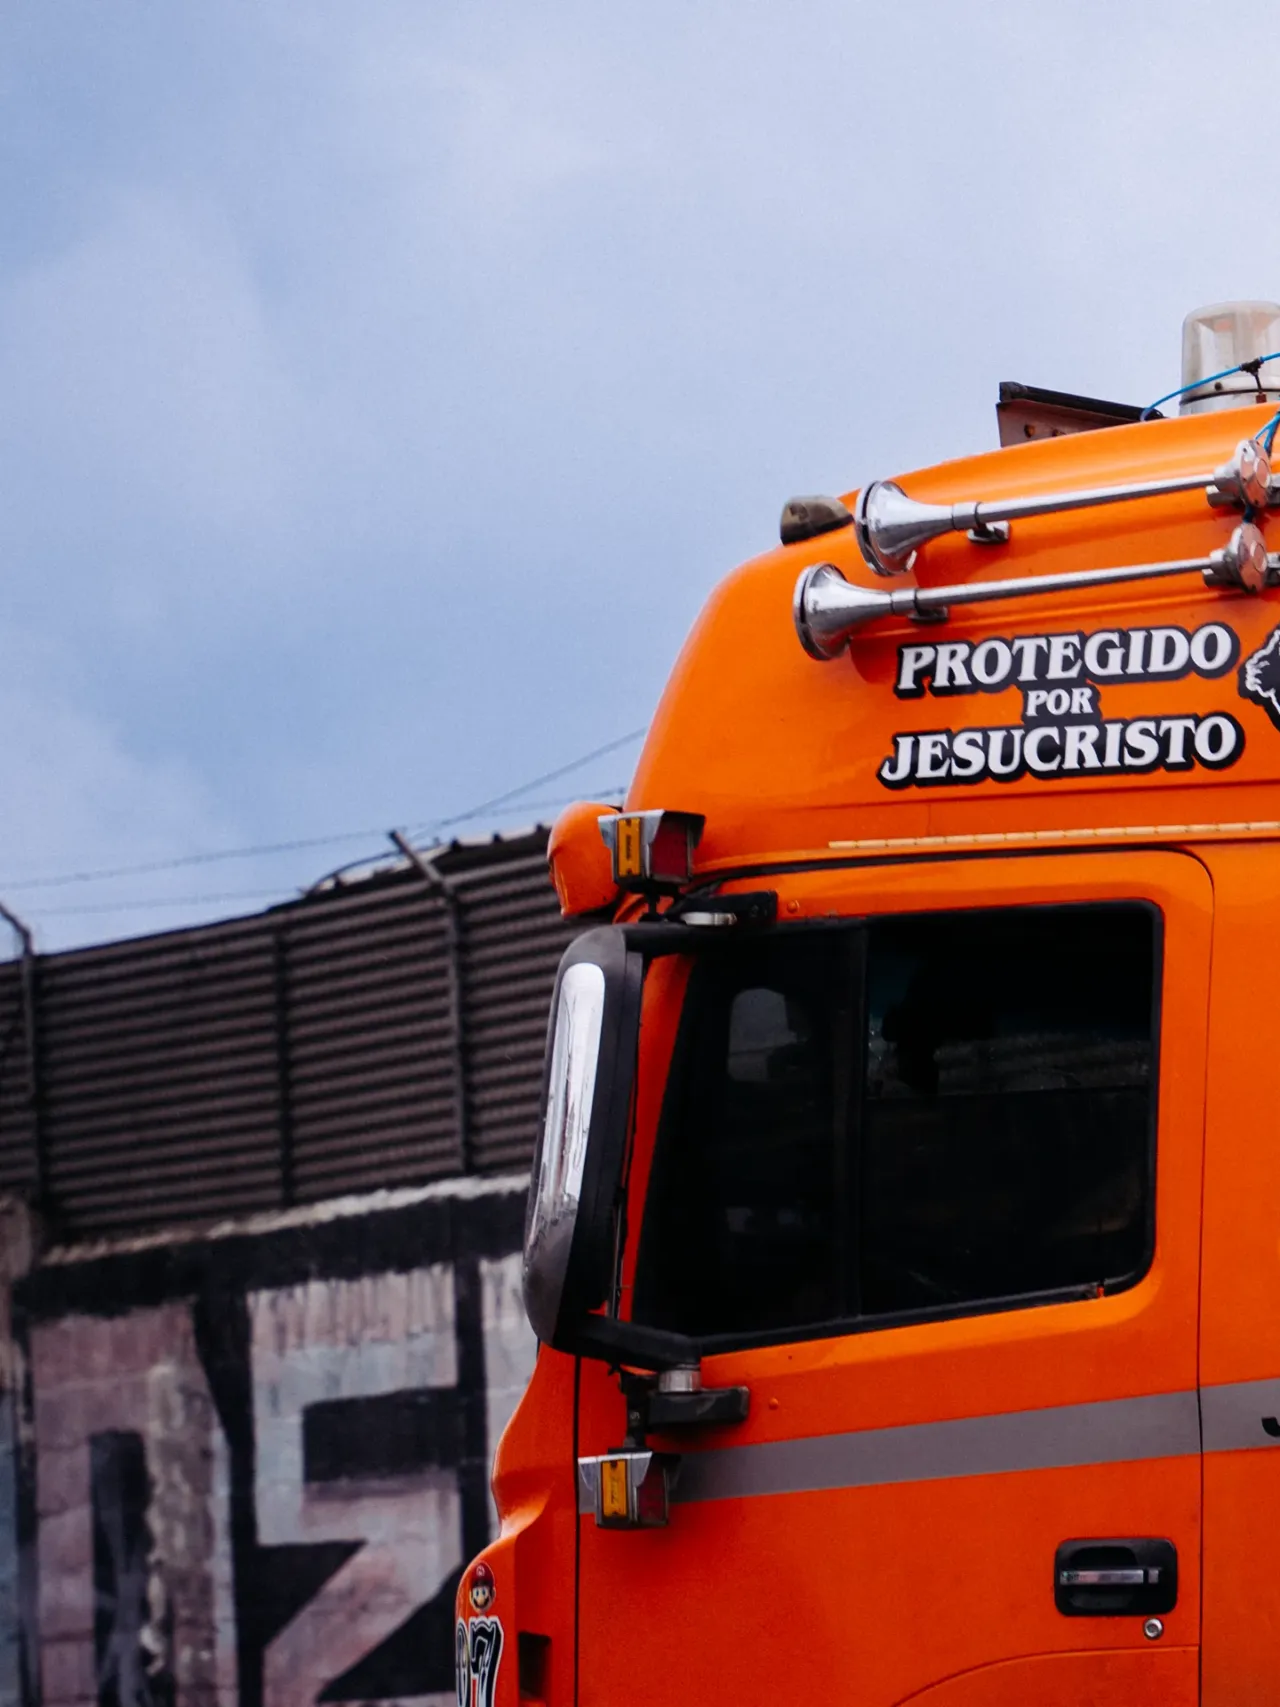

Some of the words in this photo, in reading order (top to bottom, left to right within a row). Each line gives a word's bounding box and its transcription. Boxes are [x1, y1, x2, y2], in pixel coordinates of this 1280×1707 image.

[897, 625, 1234, 690] PROTEGIDO
[1025, 688, 1093, 717] POR
[880, 716, 1237, 782] JESUCRISTO
